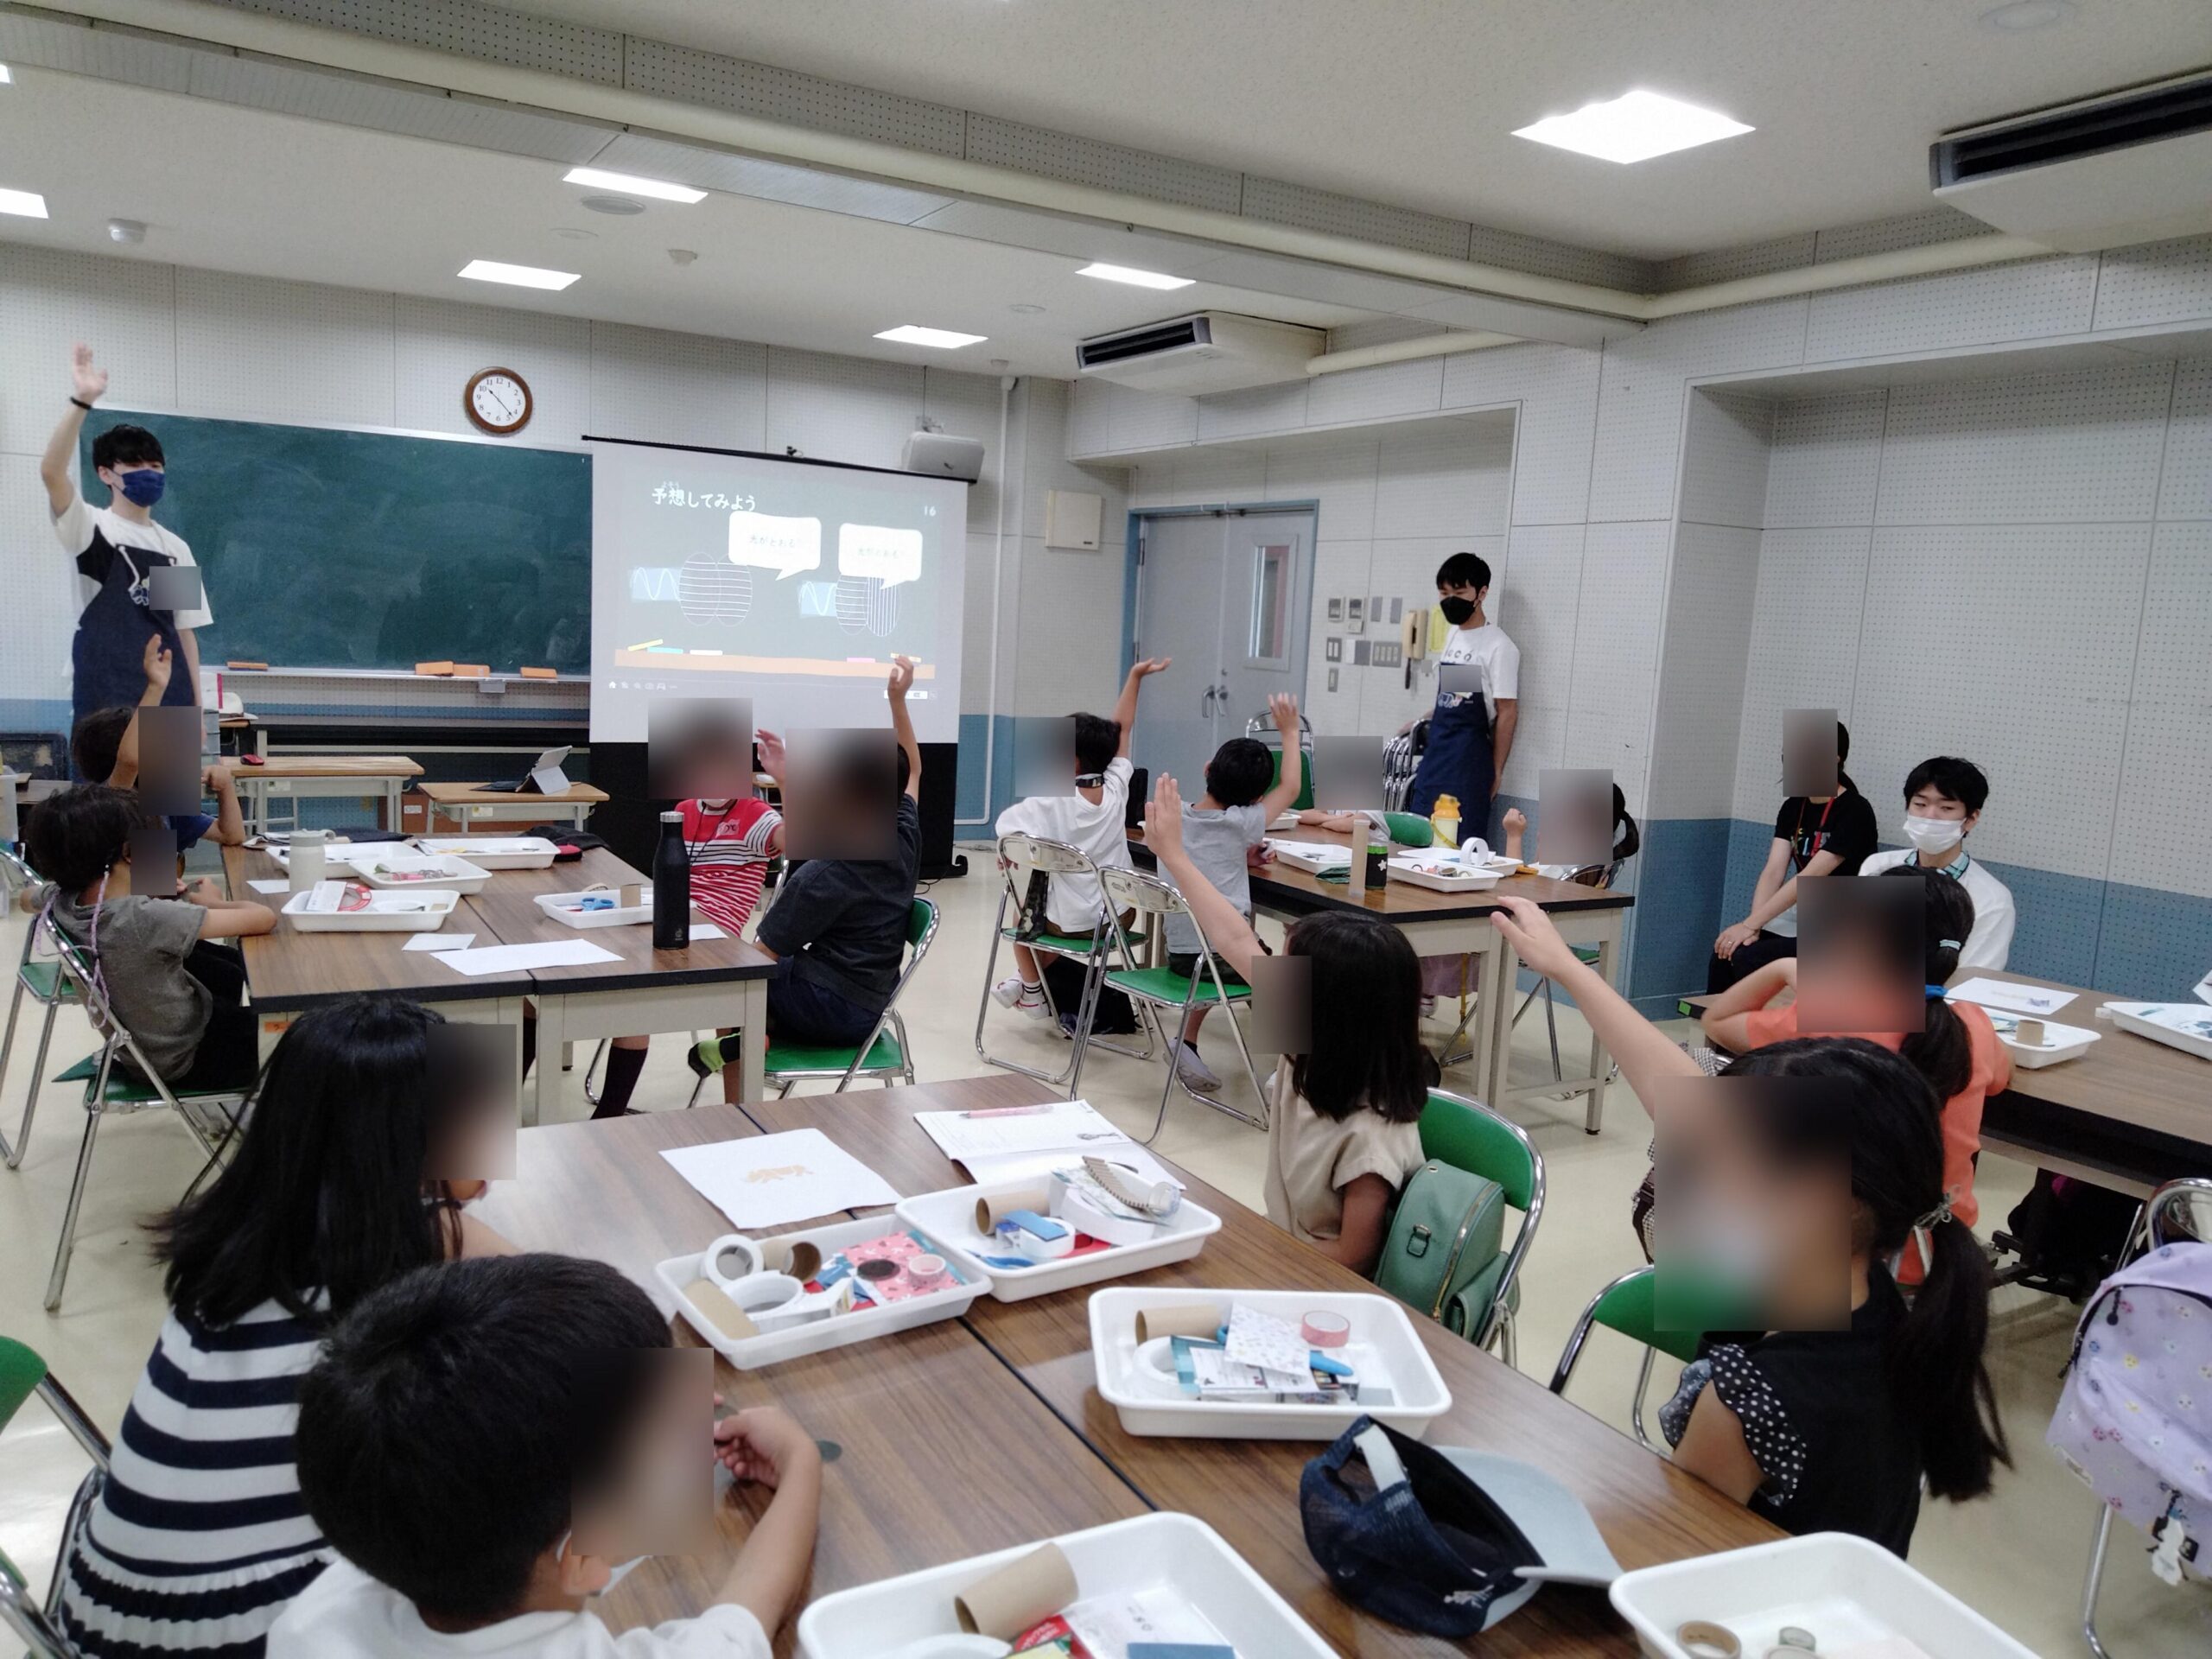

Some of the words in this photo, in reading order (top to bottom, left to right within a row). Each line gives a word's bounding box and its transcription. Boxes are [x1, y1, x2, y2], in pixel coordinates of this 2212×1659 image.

[652, 487, 756, 512] 予想してみよう
[924, 505, 937, 517] 16
